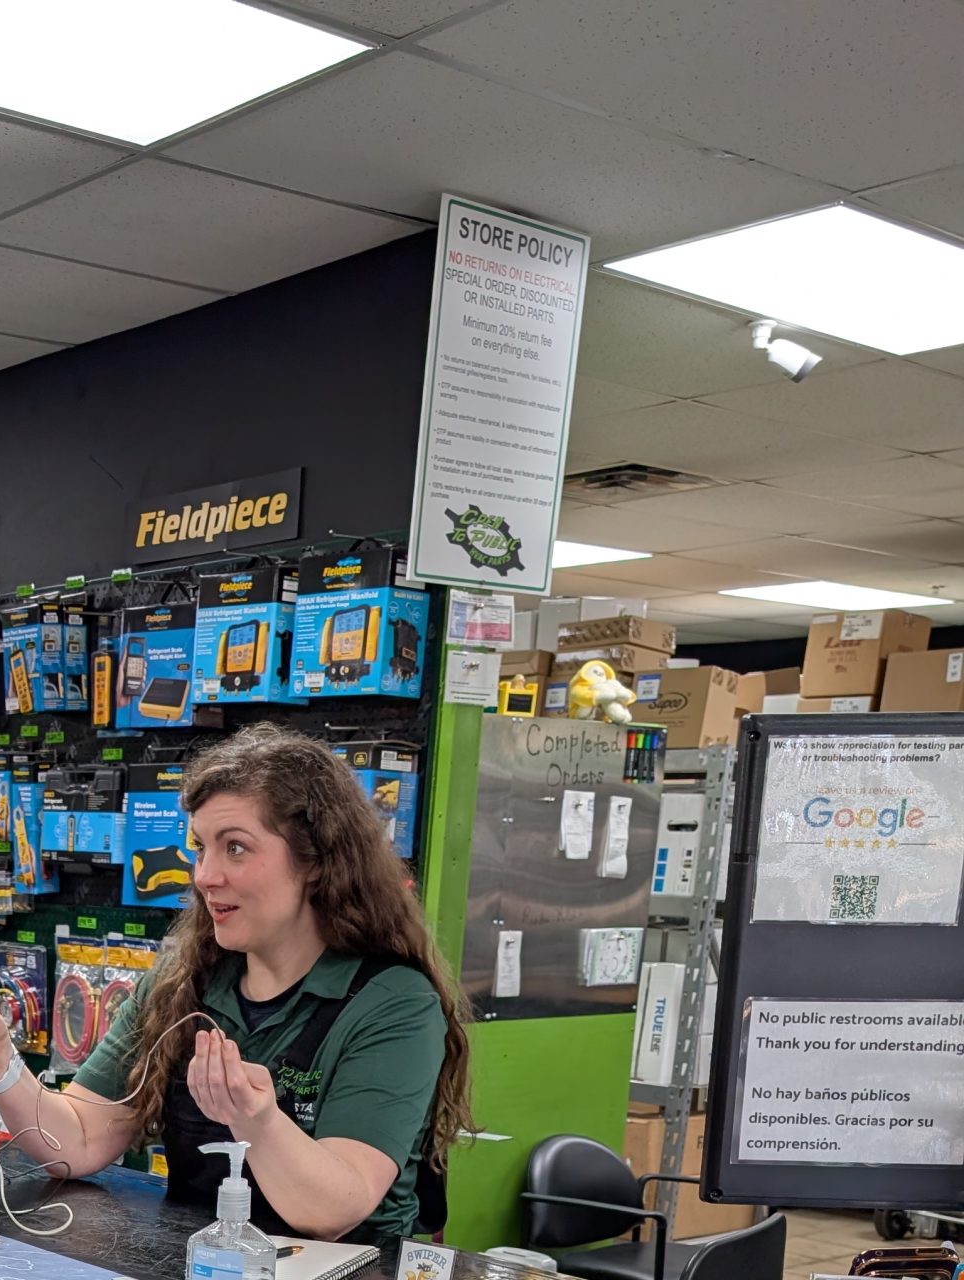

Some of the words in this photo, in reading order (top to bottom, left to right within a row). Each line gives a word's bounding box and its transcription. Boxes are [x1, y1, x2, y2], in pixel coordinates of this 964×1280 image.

[459, 217, 514, 251] STORE
[517, 233, 574, 268] POLICY
[449, 250, 463, 265] NO
[464, 254, 508, 277] RETURNS
[509, 267, 523, 280] ON
[445, 267, 483, 289] SPECIAL
[484, 278, 518, 298] ORDER,
[464, 290, 478, 304] OR
[480, 293, 526, 317] INSTALLED
[527, 306, 556, 325] PARTS.
[463, 315, 497, 333] Minimum
[499, 324, 516, 339] 20%
[518, 331, 539, 344] return
[541, 334, 553, 348] fee
[471, 336, 482, 346] on
[483, 338, 522, 360] everything
[523, 348, 540, 361] else.
[136, 492, 288, 548] Fieldpiece
[323, 565, 362, 577] Fieldpiece
[526, 723, 621, 762] Completed
[811, 742, 836, 750] show
[898, 741, 912, 750] for
[913, 742, 947, 752] testing
[948, 744, 964, 752] par
[814, 754, 887, 763] troubleshooting
[890, 754, 941, 763] problems?
[546, 762, 605, 788] Orders
[134, 810, 163, 819] Refrigerant
[135, 802, 157, 810] Wireless
[803, 796, 926, 838] Google
[652, 998, 667, 1033] TRUE
[759, 1012, 780, 1024] No
[782, 1012, 826, 1027] public
[830, 1014, 904, 1025] restrooms
[756, 1037, 800, 1050] Thank
[803, 1040, 831, 1053] you
[835, 1038, 857, 1050] for
[859, 1039, 964, 1055] understanding
[751, 1087, 772, 1099] No
[775, 1087, 802, 1102] hay
[805, 1087, 848, 1101] baños
[850, 1087, 911, 1104] públicos
[748, 1112, 831, 1127] disponibles.
[835, 1114, 886, 1127] Gracias
[889, 1116, 914, 1130] por
[917, 1118, 934, 1128] su
[746, 1137, 842, 1152] comprensión.
[407, 1248, 447, 1269] SWIPER
